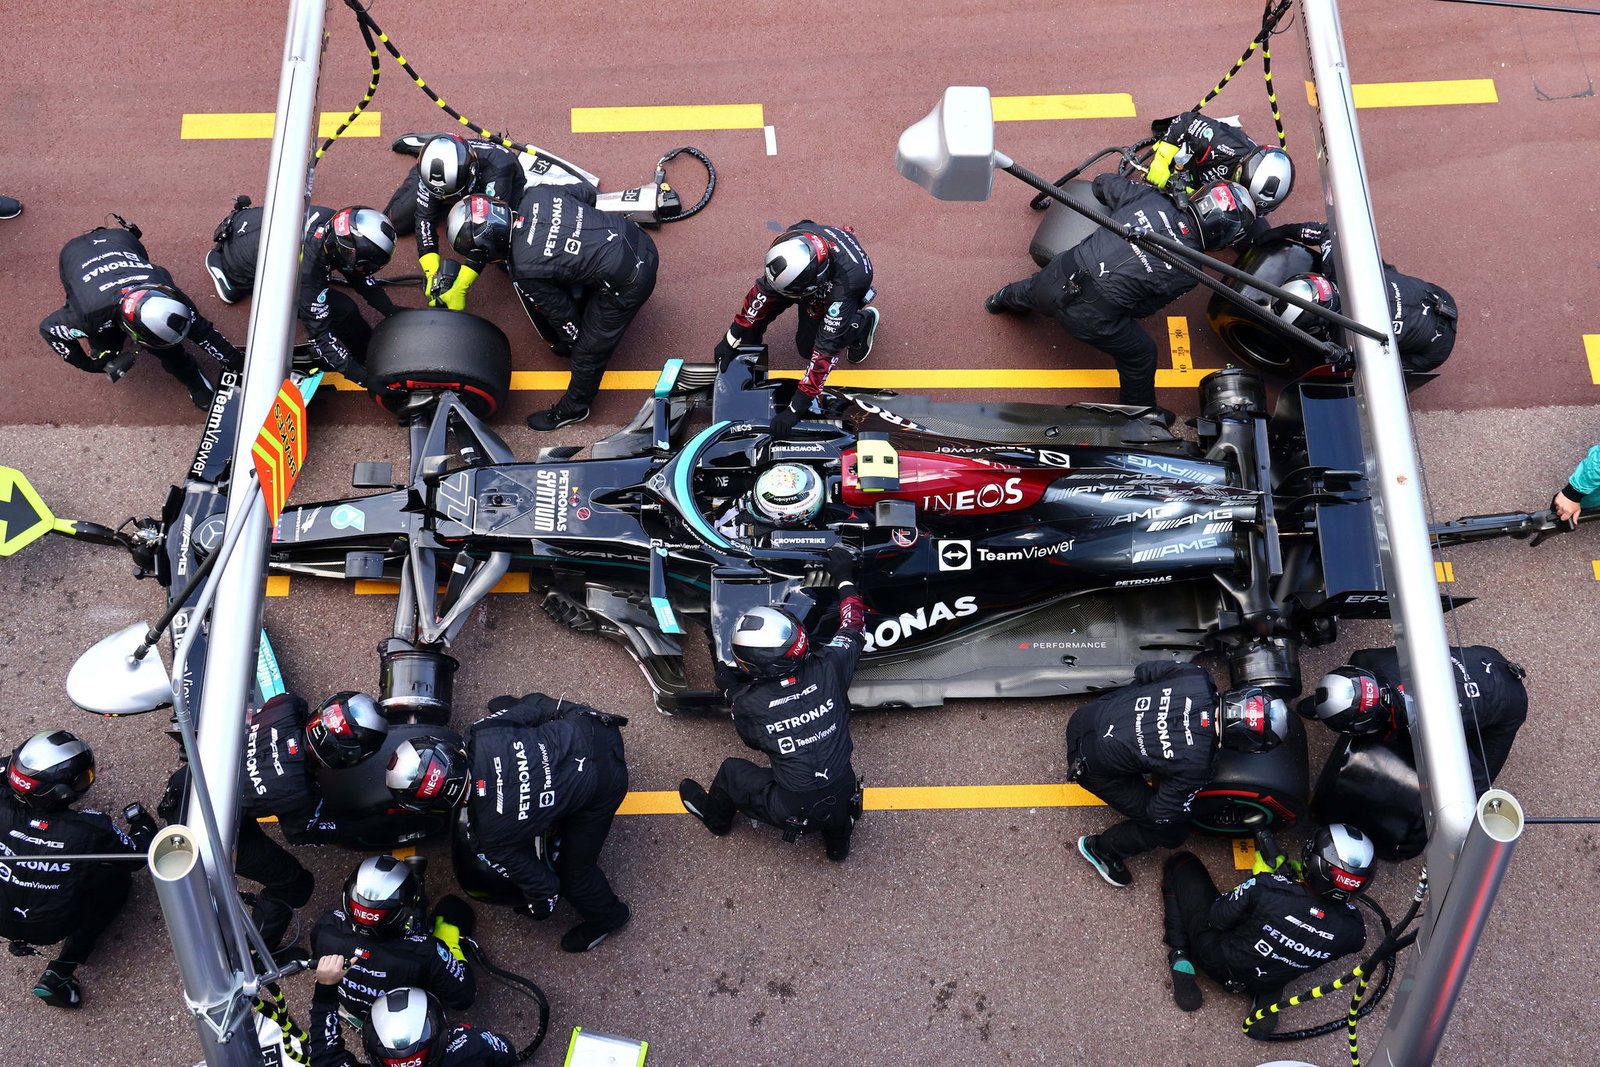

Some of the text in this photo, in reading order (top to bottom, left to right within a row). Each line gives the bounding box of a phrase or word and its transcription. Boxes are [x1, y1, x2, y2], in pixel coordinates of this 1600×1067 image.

[533, 158, 550, 173] RF1
[544, 197, 563, 257] PETRONAS
[192, 389, 233, 476] TeamViewer
[274, 403, 297, 478] BRAKES
[285, 413, 297, 442] ON
[556, 469, 570, 532] PETRONAS
[923, 478, 1023, 511] INEOS
[771, 537, 826, 545] CROWDSTRIKE
[977, 539, 1076, 562] TeamViewer
[1115, 575, 1172, 587] PETRONAS
[1345, 594, 1390, 603] EPS
[1033, 641, 1107, 650] PERFORMANCE
[1365, 682, 1375, 707] INEOS
[328, 708, 345, 734] INEOS
[766, 698, 834, 735] PETRONAS
[1156, 687, 1175, 759] PETRONAS
[795, 723, 838, 748] TeamViewer
[1135, 712, 1149, 757] TeamViewer
[246, 723, 267, 796] PETRONAS
[538, 742, 553, 790] TeamViewer
[9, 772, 32, 790] INEOS
[424, 768, 442, 796] INEOS
[513, 740, 532, 821] PETRONAS
[11, 875, 61, 890] TeamViewer
[1335, 873, 1362, 889] INEOS
[353, 907, 380, 922] INEOS
[1262, 923, 1332, 960] PETRONAS
[342, 976, 386, 998] TRONA
